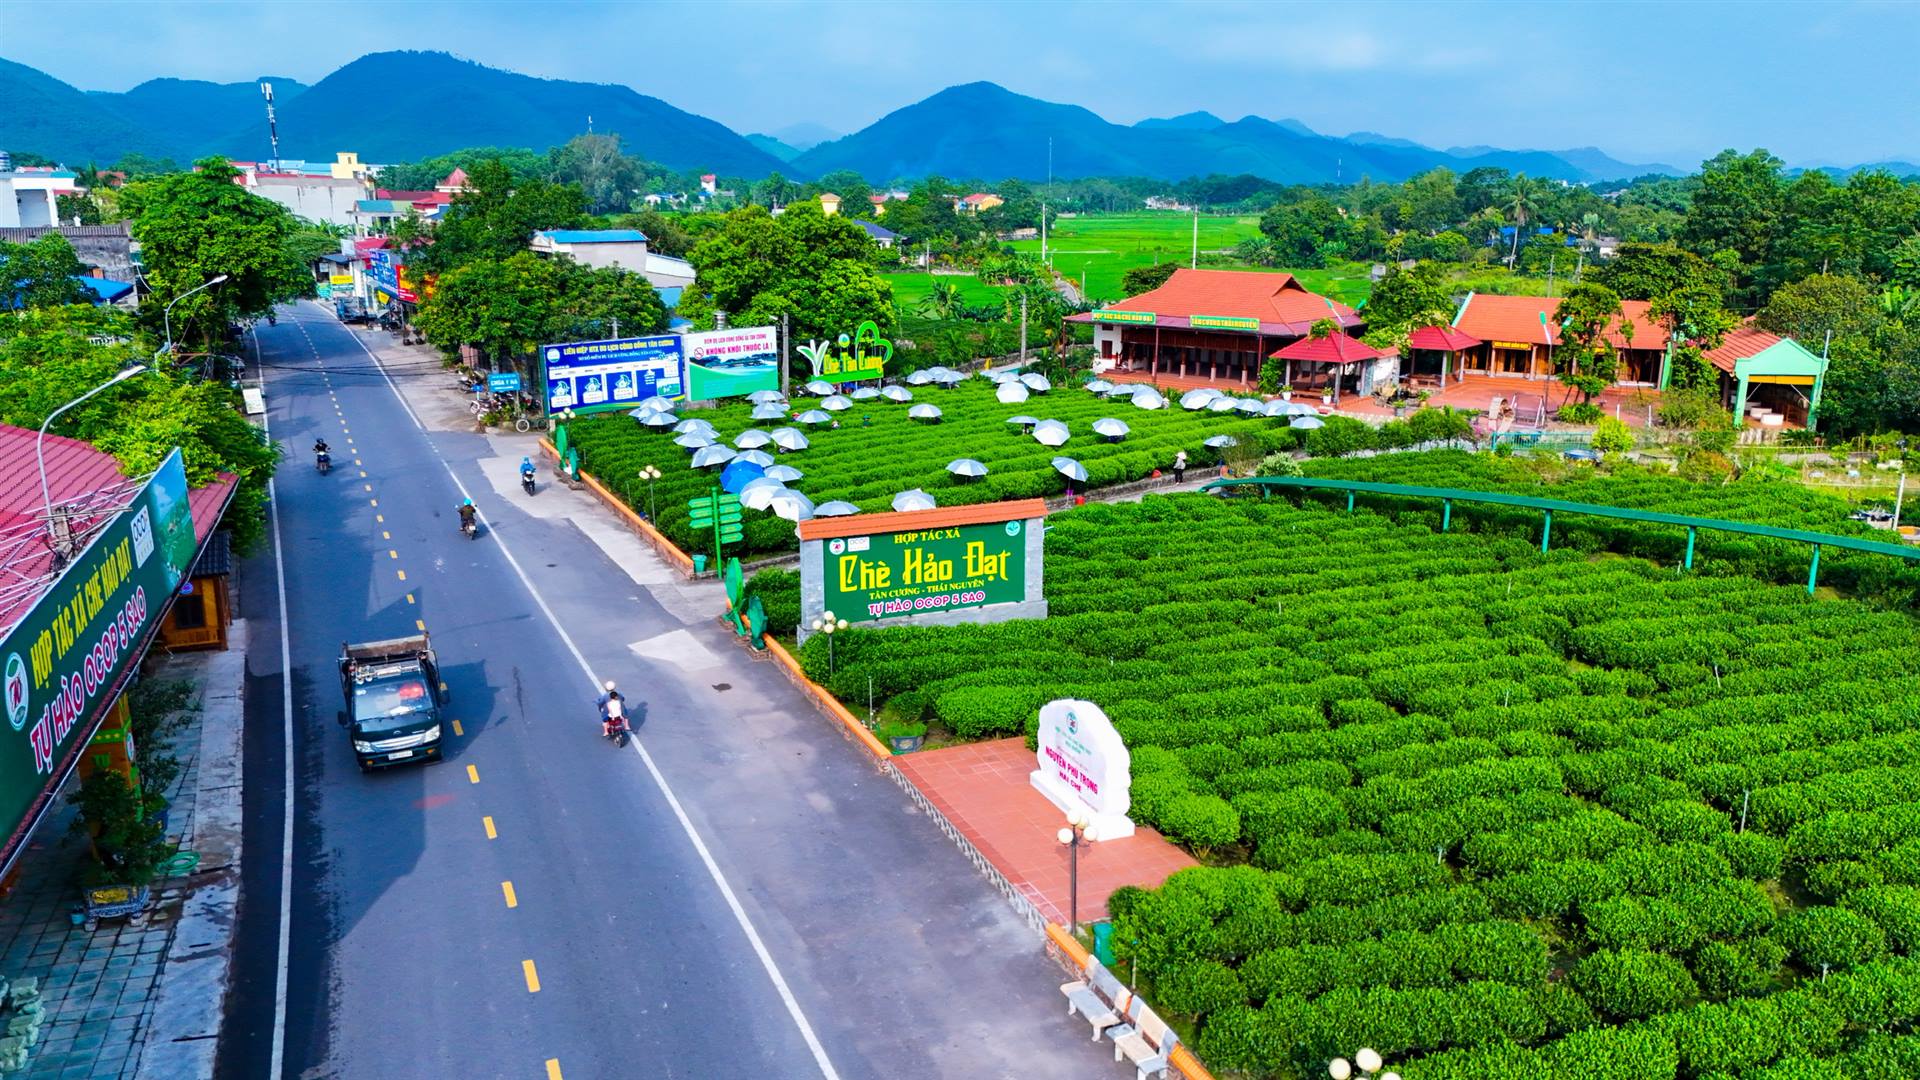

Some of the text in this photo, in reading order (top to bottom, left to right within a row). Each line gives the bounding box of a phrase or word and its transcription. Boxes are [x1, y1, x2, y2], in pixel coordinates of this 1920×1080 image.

[894, 527, 961, 544] HỢP TÁC XÃ
[839, 541, 1011, 593] Chè Hảo Đạt
[869, 590, 887, 600] TÂN
[888, 587, 920, 598] CƯƠNG
[927, 583, 947, 593] THÁI
[949, 579, 984, 591] NGUYÊN
[869, 591, 985, 617] TỰ HÀO OCOP 5 SAO
[30, 536, 133, 689] HỢP TÁC XÃ CHÈ HẢO ĐẠT
[30, 585, 147, 774] TỰ HÀO OCOP 5 SAO
